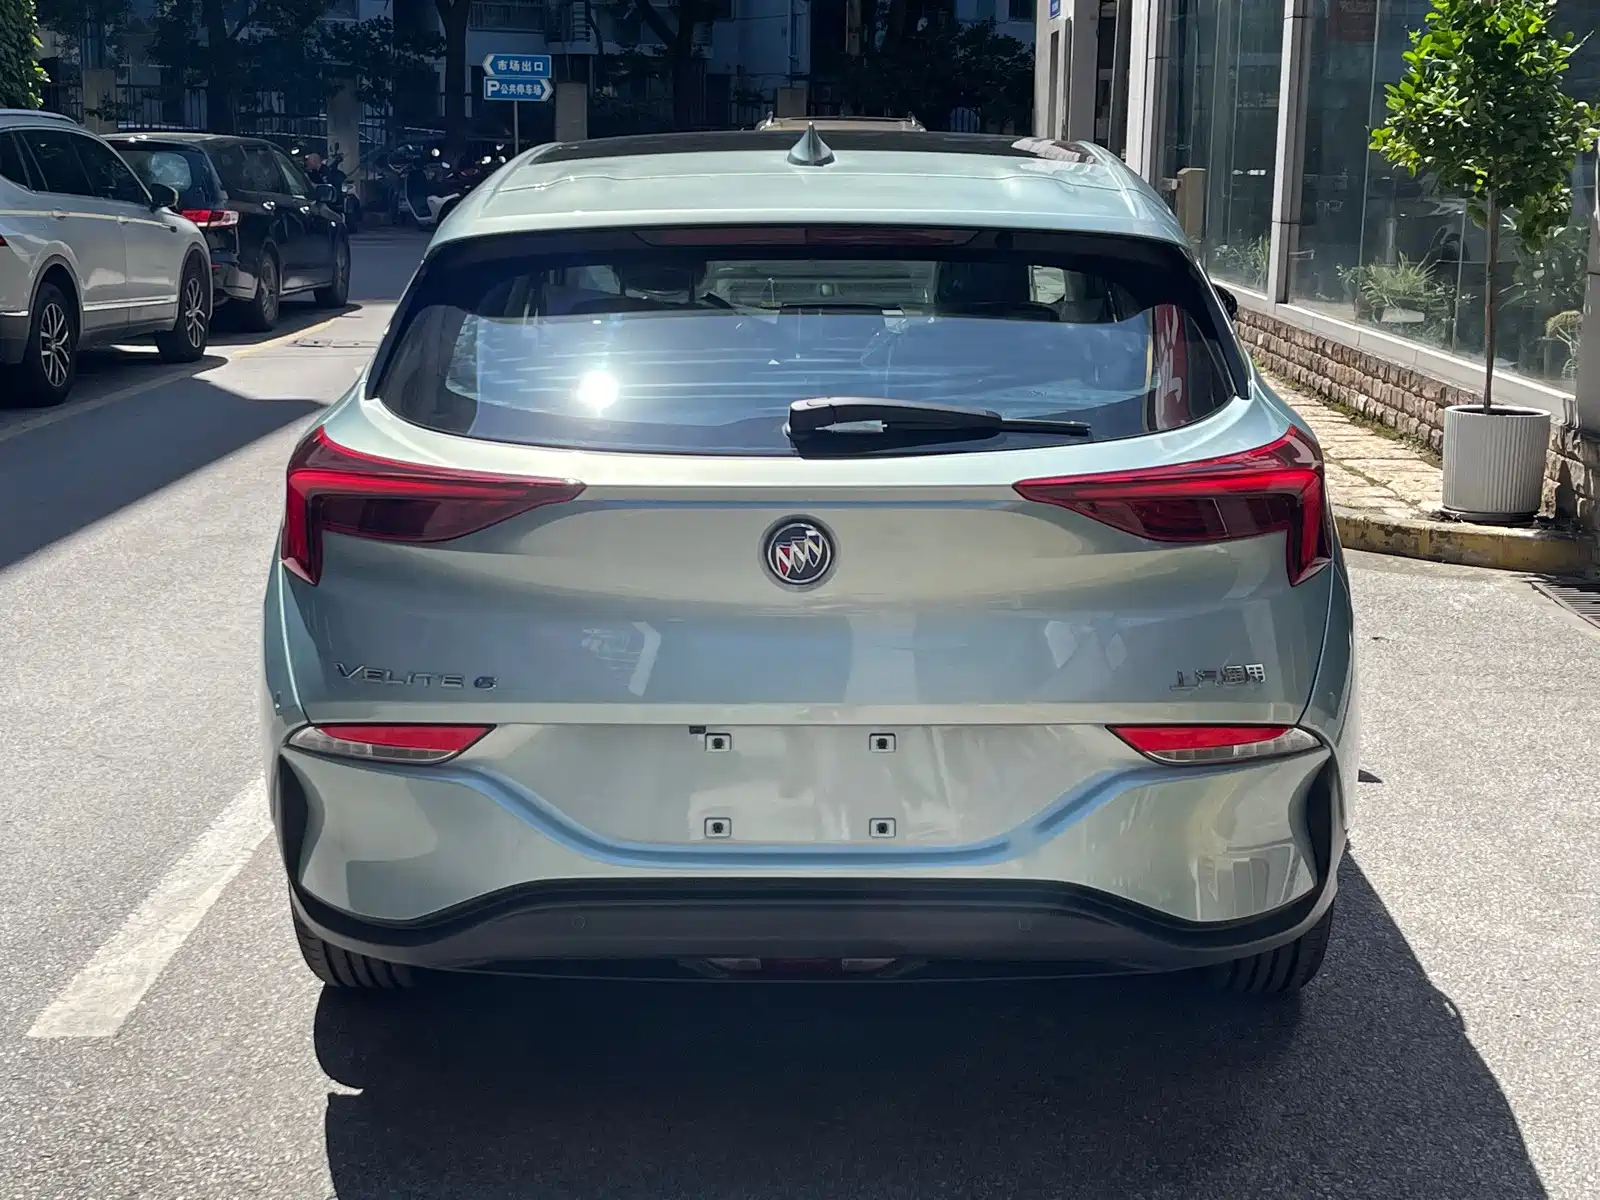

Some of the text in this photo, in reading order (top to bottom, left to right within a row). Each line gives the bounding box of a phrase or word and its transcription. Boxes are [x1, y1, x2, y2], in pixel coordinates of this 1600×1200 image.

[497, 60, 544, 72] 市场出口
[487, 80, 542, 96] P 公共停车场
[334, 662, 500, 691] VELITE 6
